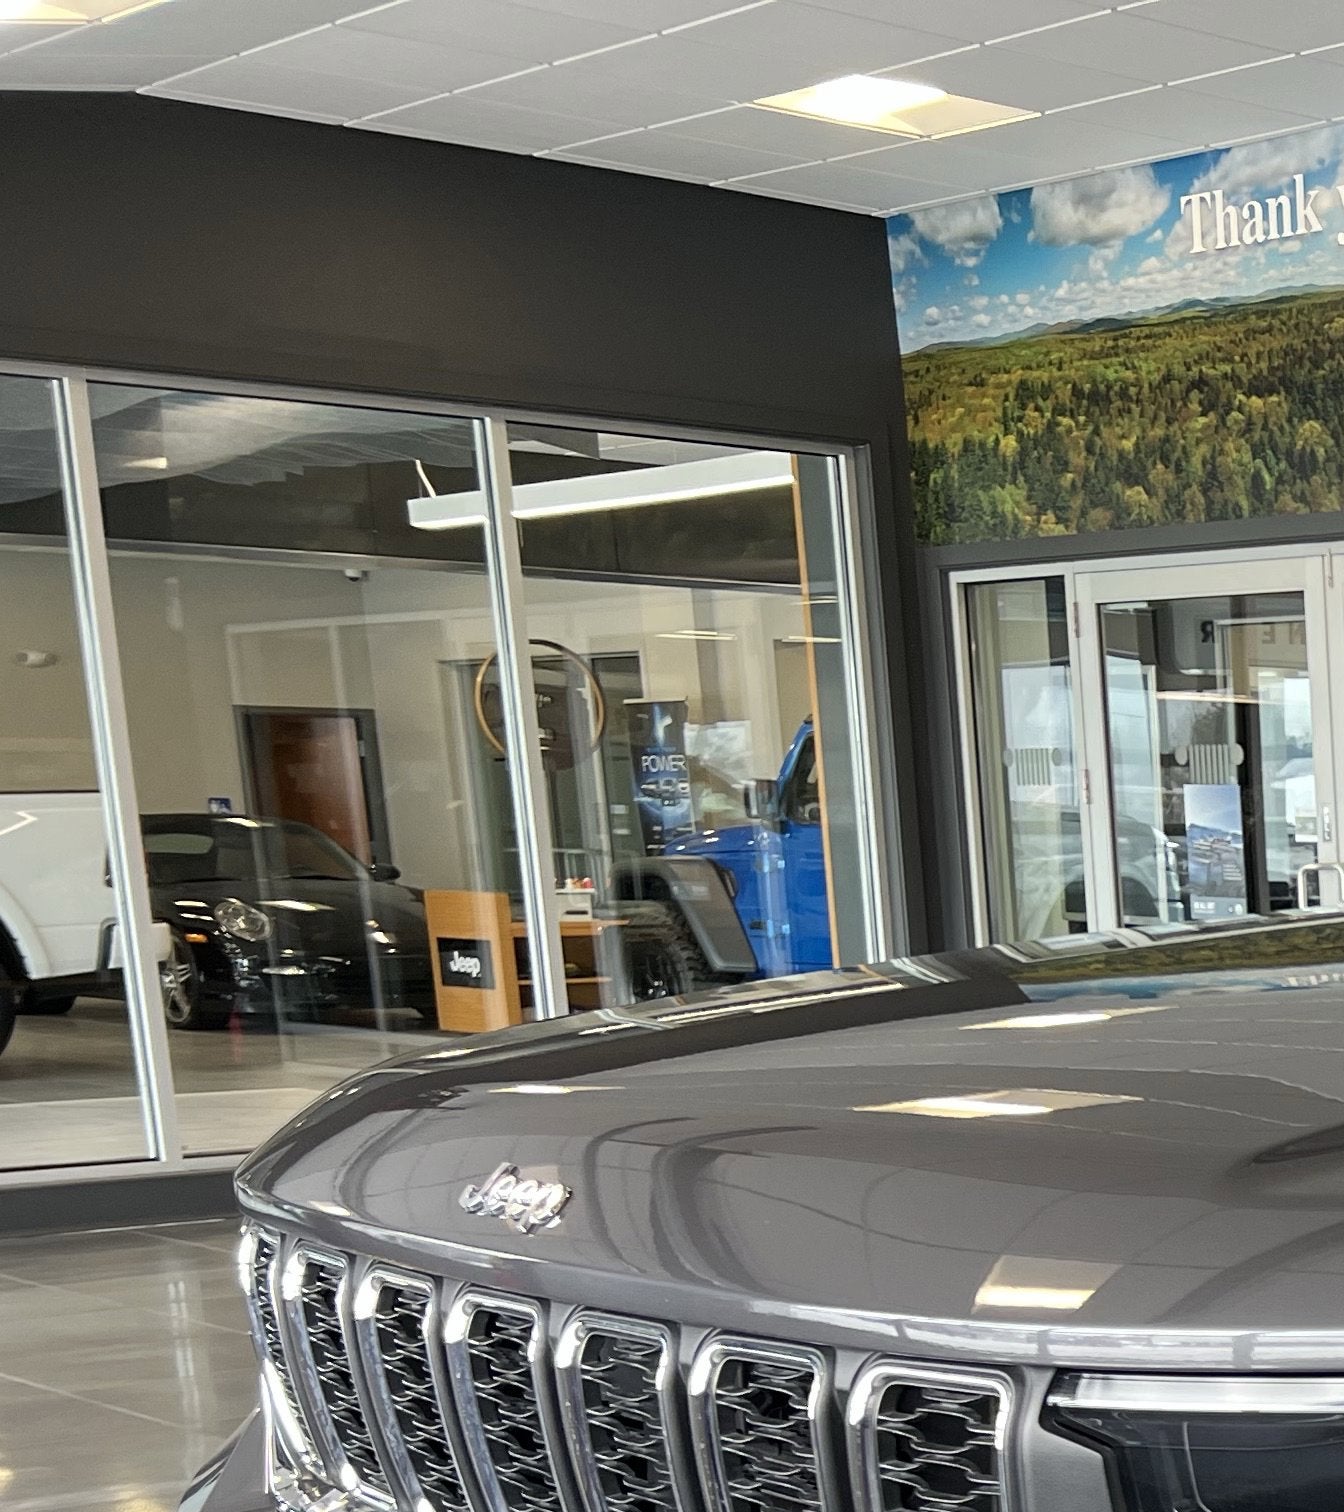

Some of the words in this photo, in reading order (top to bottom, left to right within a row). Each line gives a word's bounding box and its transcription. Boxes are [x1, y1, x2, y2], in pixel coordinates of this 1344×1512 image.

[1180, 173, 1324, 255] Thank
[641, 753, 688, 773] POWER
[449, 950, 483, 978] Jeep
[458, 1161, 574, 1238] Jeep
